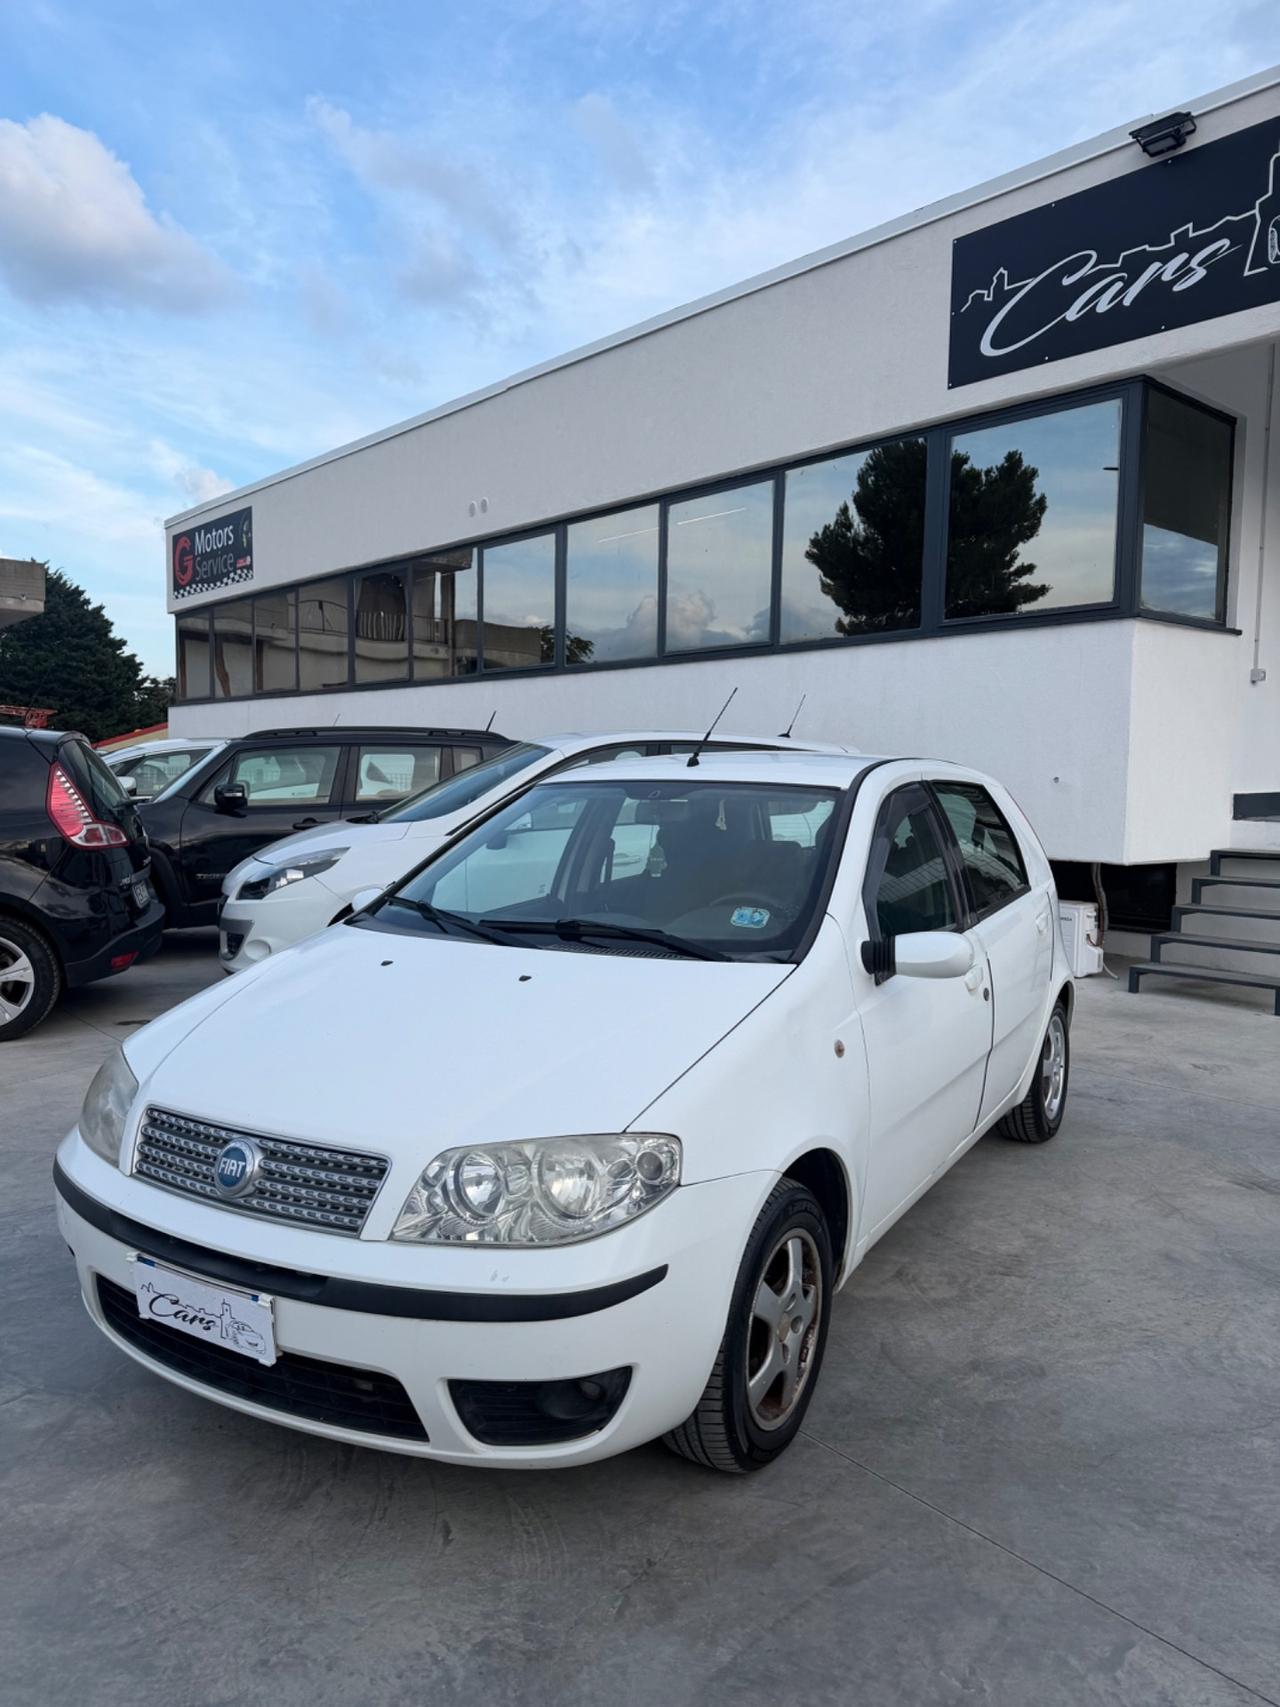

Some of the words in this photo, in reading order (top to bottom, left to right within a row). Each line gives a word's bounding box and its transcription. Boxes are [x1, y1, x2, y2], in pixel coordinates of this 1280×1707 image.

[980, 238, 1241, 357] Cars
[195, 525, 234, 556] Motors
[195, 551, 234, 581] Service
[218, 1157, 246, 1178] FIAT
[149, 1293, 217, 1331] Cars
